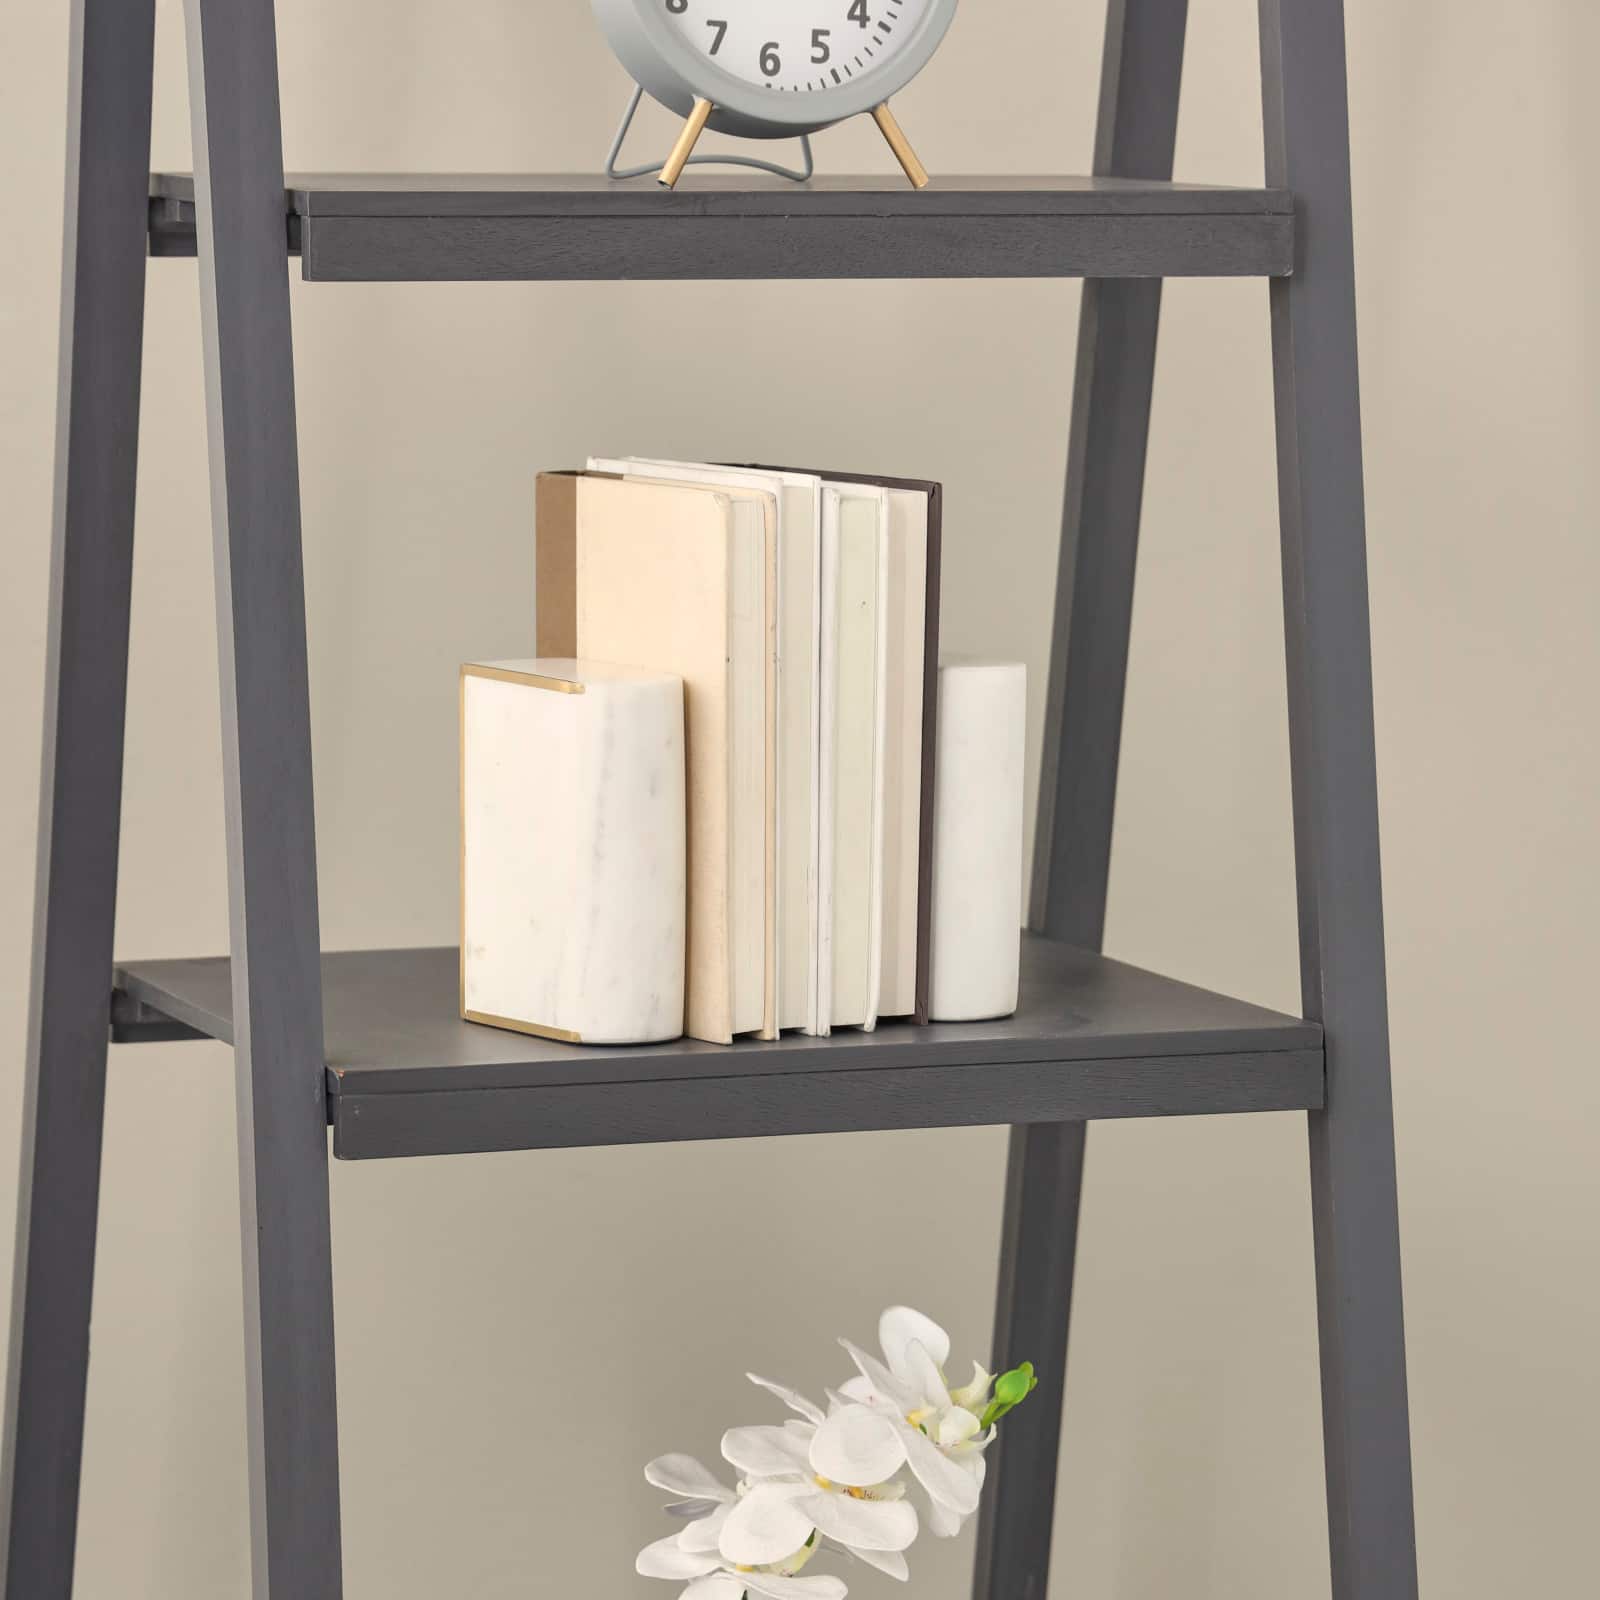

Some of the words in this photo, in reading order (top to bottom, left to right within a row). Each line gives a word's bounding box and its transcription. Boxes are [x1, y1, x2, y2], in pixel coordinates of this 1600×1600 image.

[847, 0, 871, 29] 4
[706, 20, 728, 56] 7
[810, 29, 830, 64] 5
[759, 42, 781, 77] 6
